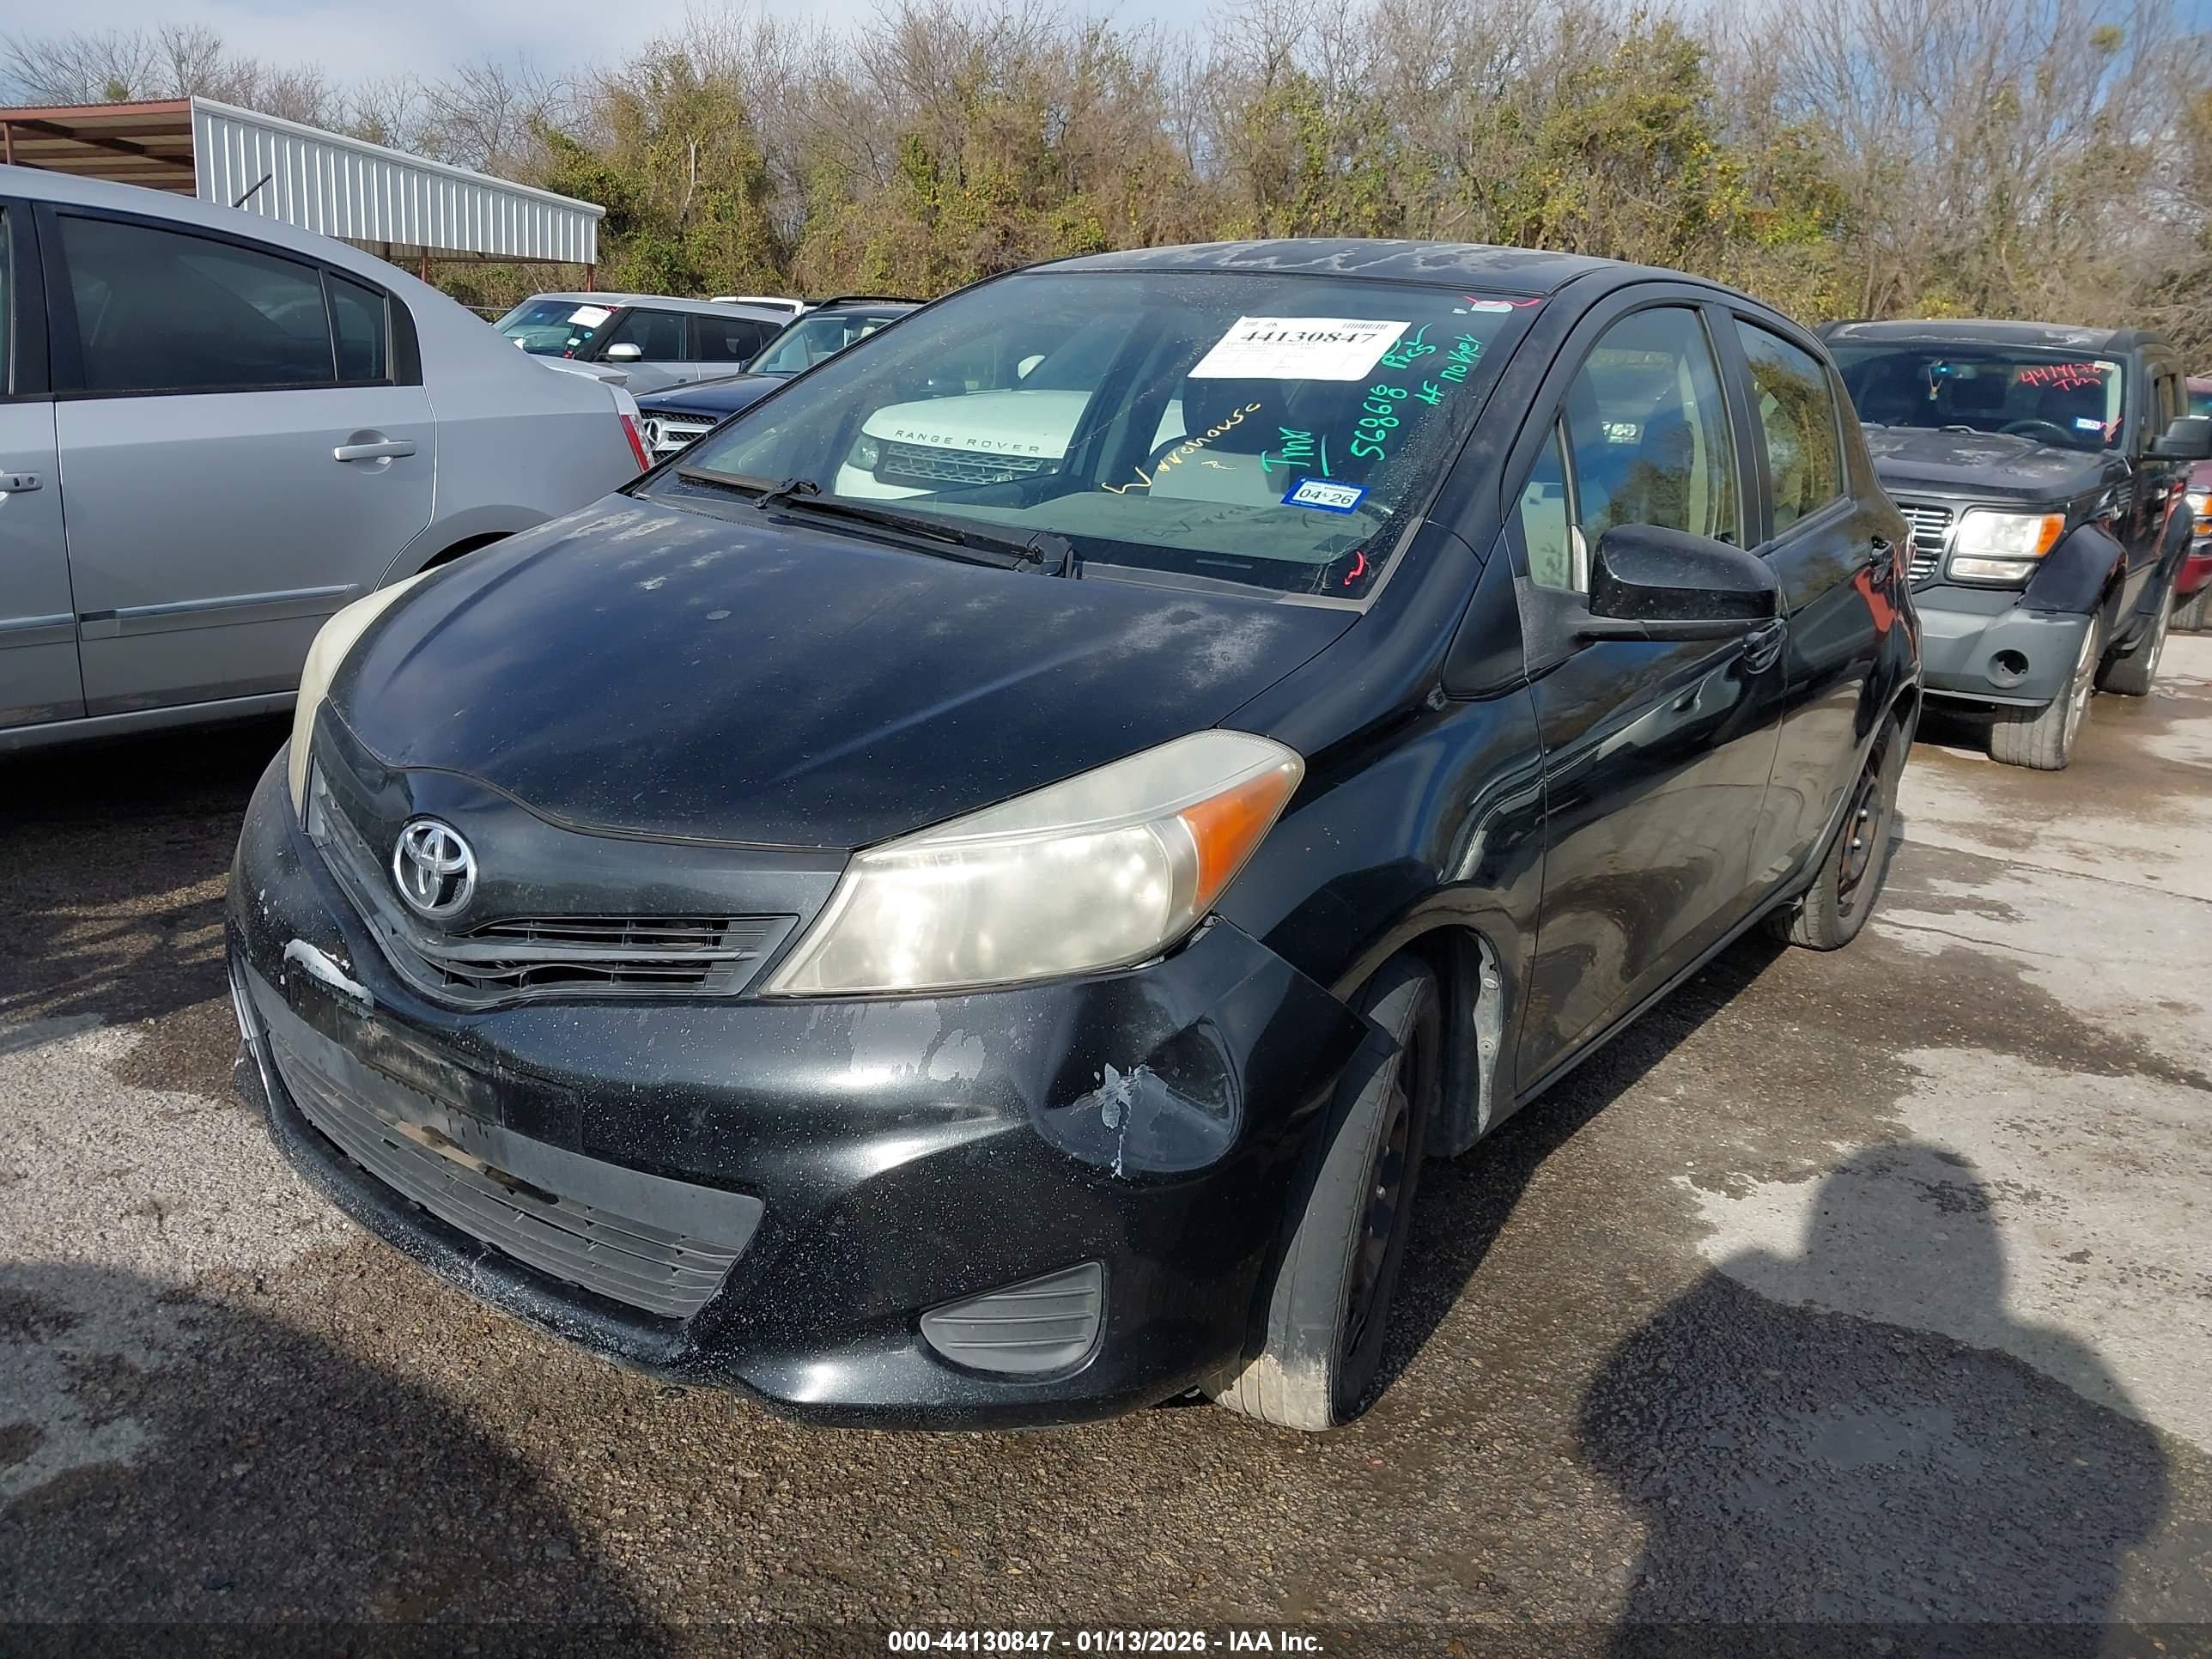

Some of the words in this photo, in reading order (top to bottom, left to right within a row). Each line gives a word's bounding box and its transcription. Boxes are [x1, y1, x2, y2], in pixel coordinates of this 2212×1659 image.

[1240, 331, 1378, 344] 44130847
[895, 429, 954, 445] RANGE
[965, 438, 1040, 454] ROVER
